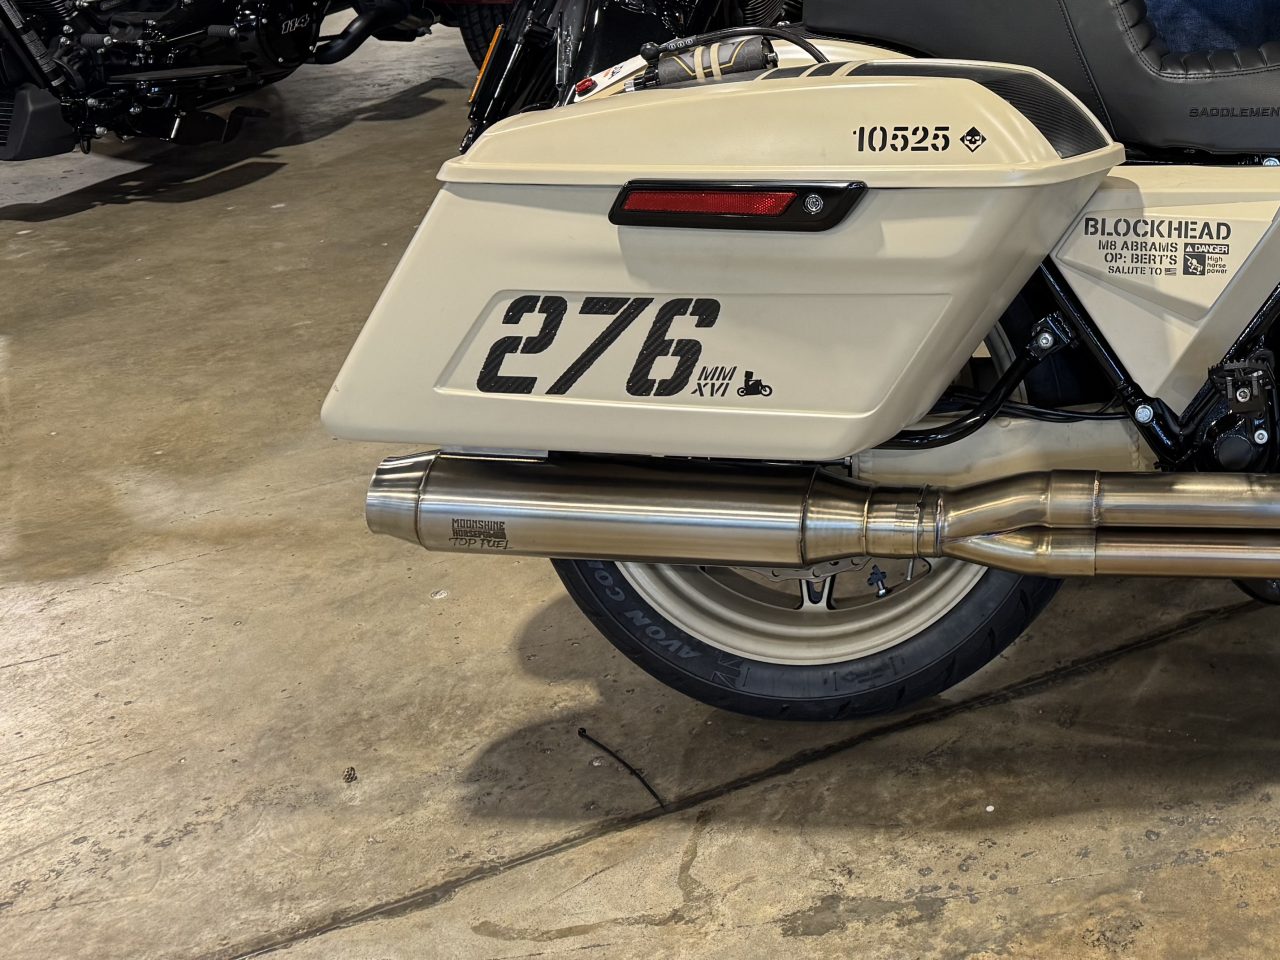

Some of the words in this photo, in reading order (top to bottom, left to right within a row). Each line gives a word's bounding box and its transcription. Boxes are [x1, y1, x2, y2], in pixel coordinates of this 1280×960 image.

[1189, 106, 1280, 118] SADDLEMEN
[852, 126, 950, 152] 10525
[1084, 217, 1232, 241] BLOCKHEAD
[1098, 239, 1117, 251] M8
[1120, 240, 1178, 253] ABRAMS
[1194, 244, 1229, 254] DANGER
[1104, 252, 1127, 264] OP:
[1130, 253, 1178, 266] BERT'S
[1207, 255, 1223, 263] High
[1108, 265, 1146, 276] SALUTE
[1149, 266, 1163, 276] TO
[1206, 267, 1228, 276] power
[476, 294, 721, 398] 276
[696, 365, 738, 382] MM
[690, 381, 733, 398] XVI
[451, 518, 506, 531] MOONSHINE
[448, 537, 477, 548] TOP
[479, 538, 514, 550] FUEL
[623, 609, 703, 659] AVON
